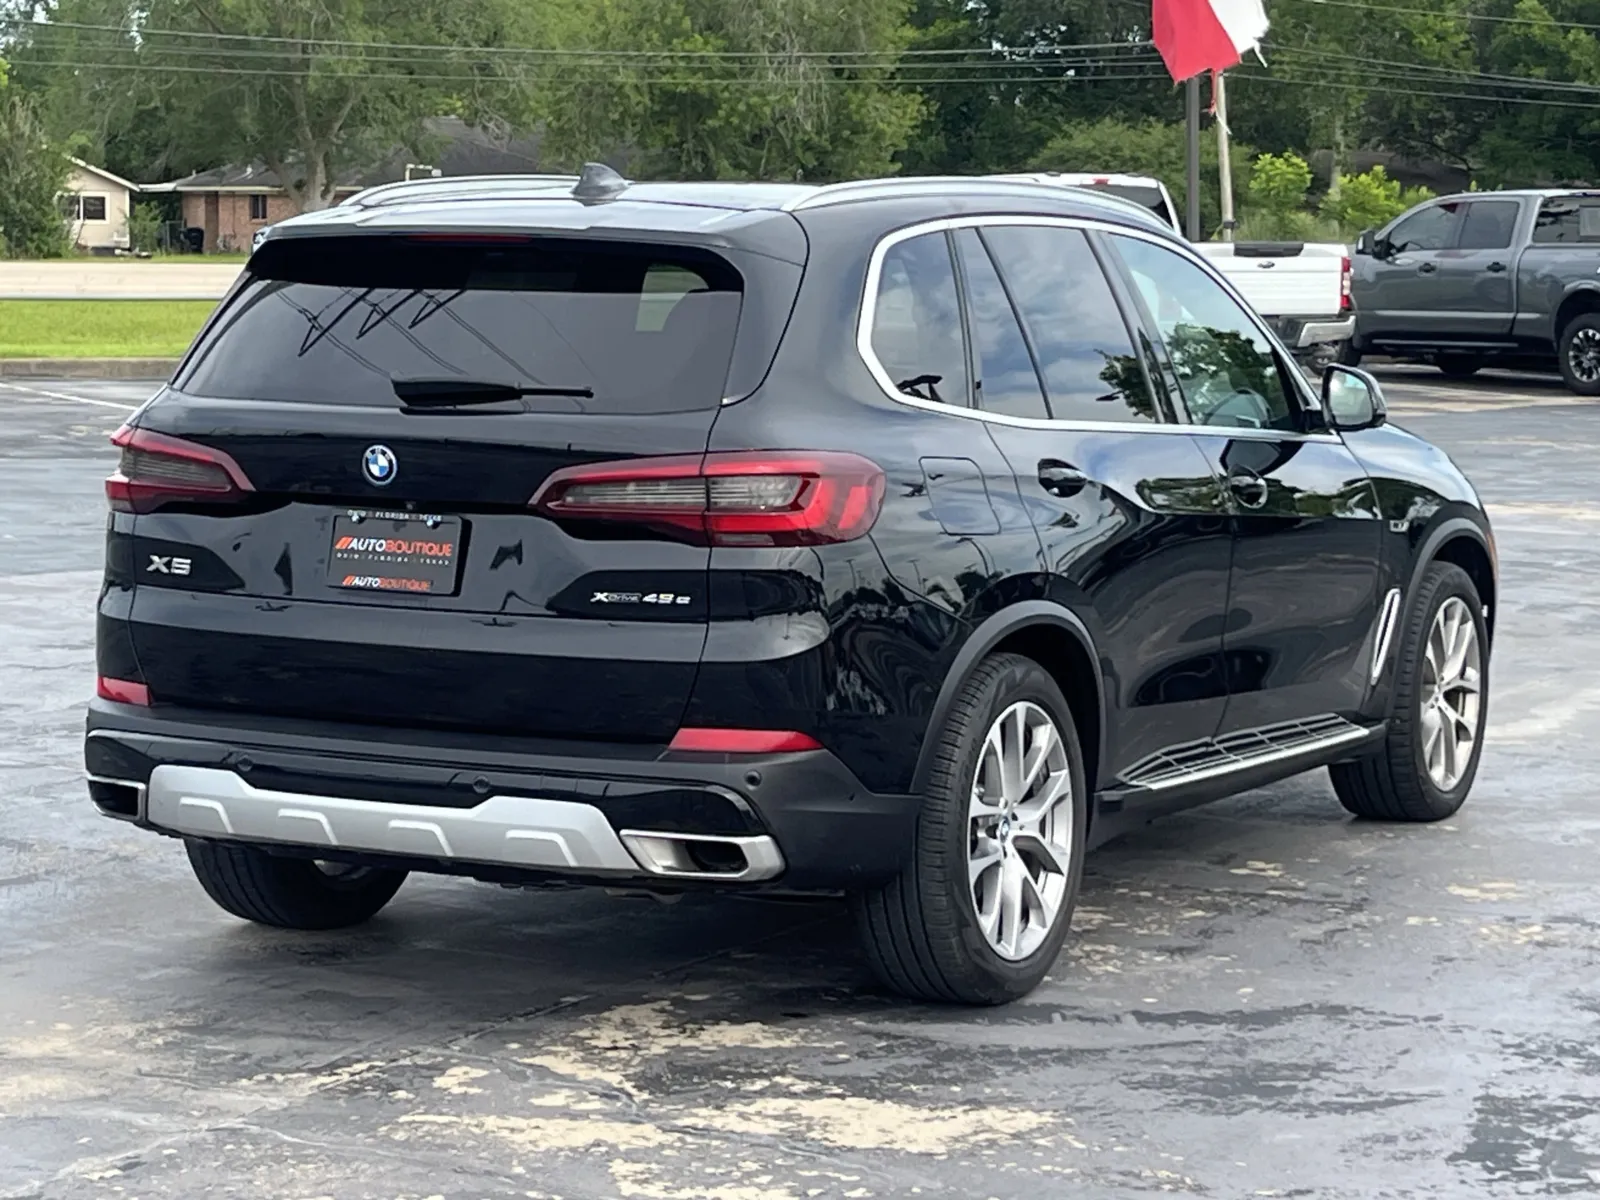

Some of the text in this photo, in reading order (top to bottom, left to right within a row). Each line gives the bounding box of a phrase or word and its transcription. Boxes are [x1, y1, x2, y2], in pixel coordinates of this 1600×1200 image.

[375, 511, 410, 520] FLORIDA
[347, 537, 453, 557] AUTOBOUTIQUE
[146, 554, 192, 575] X5
